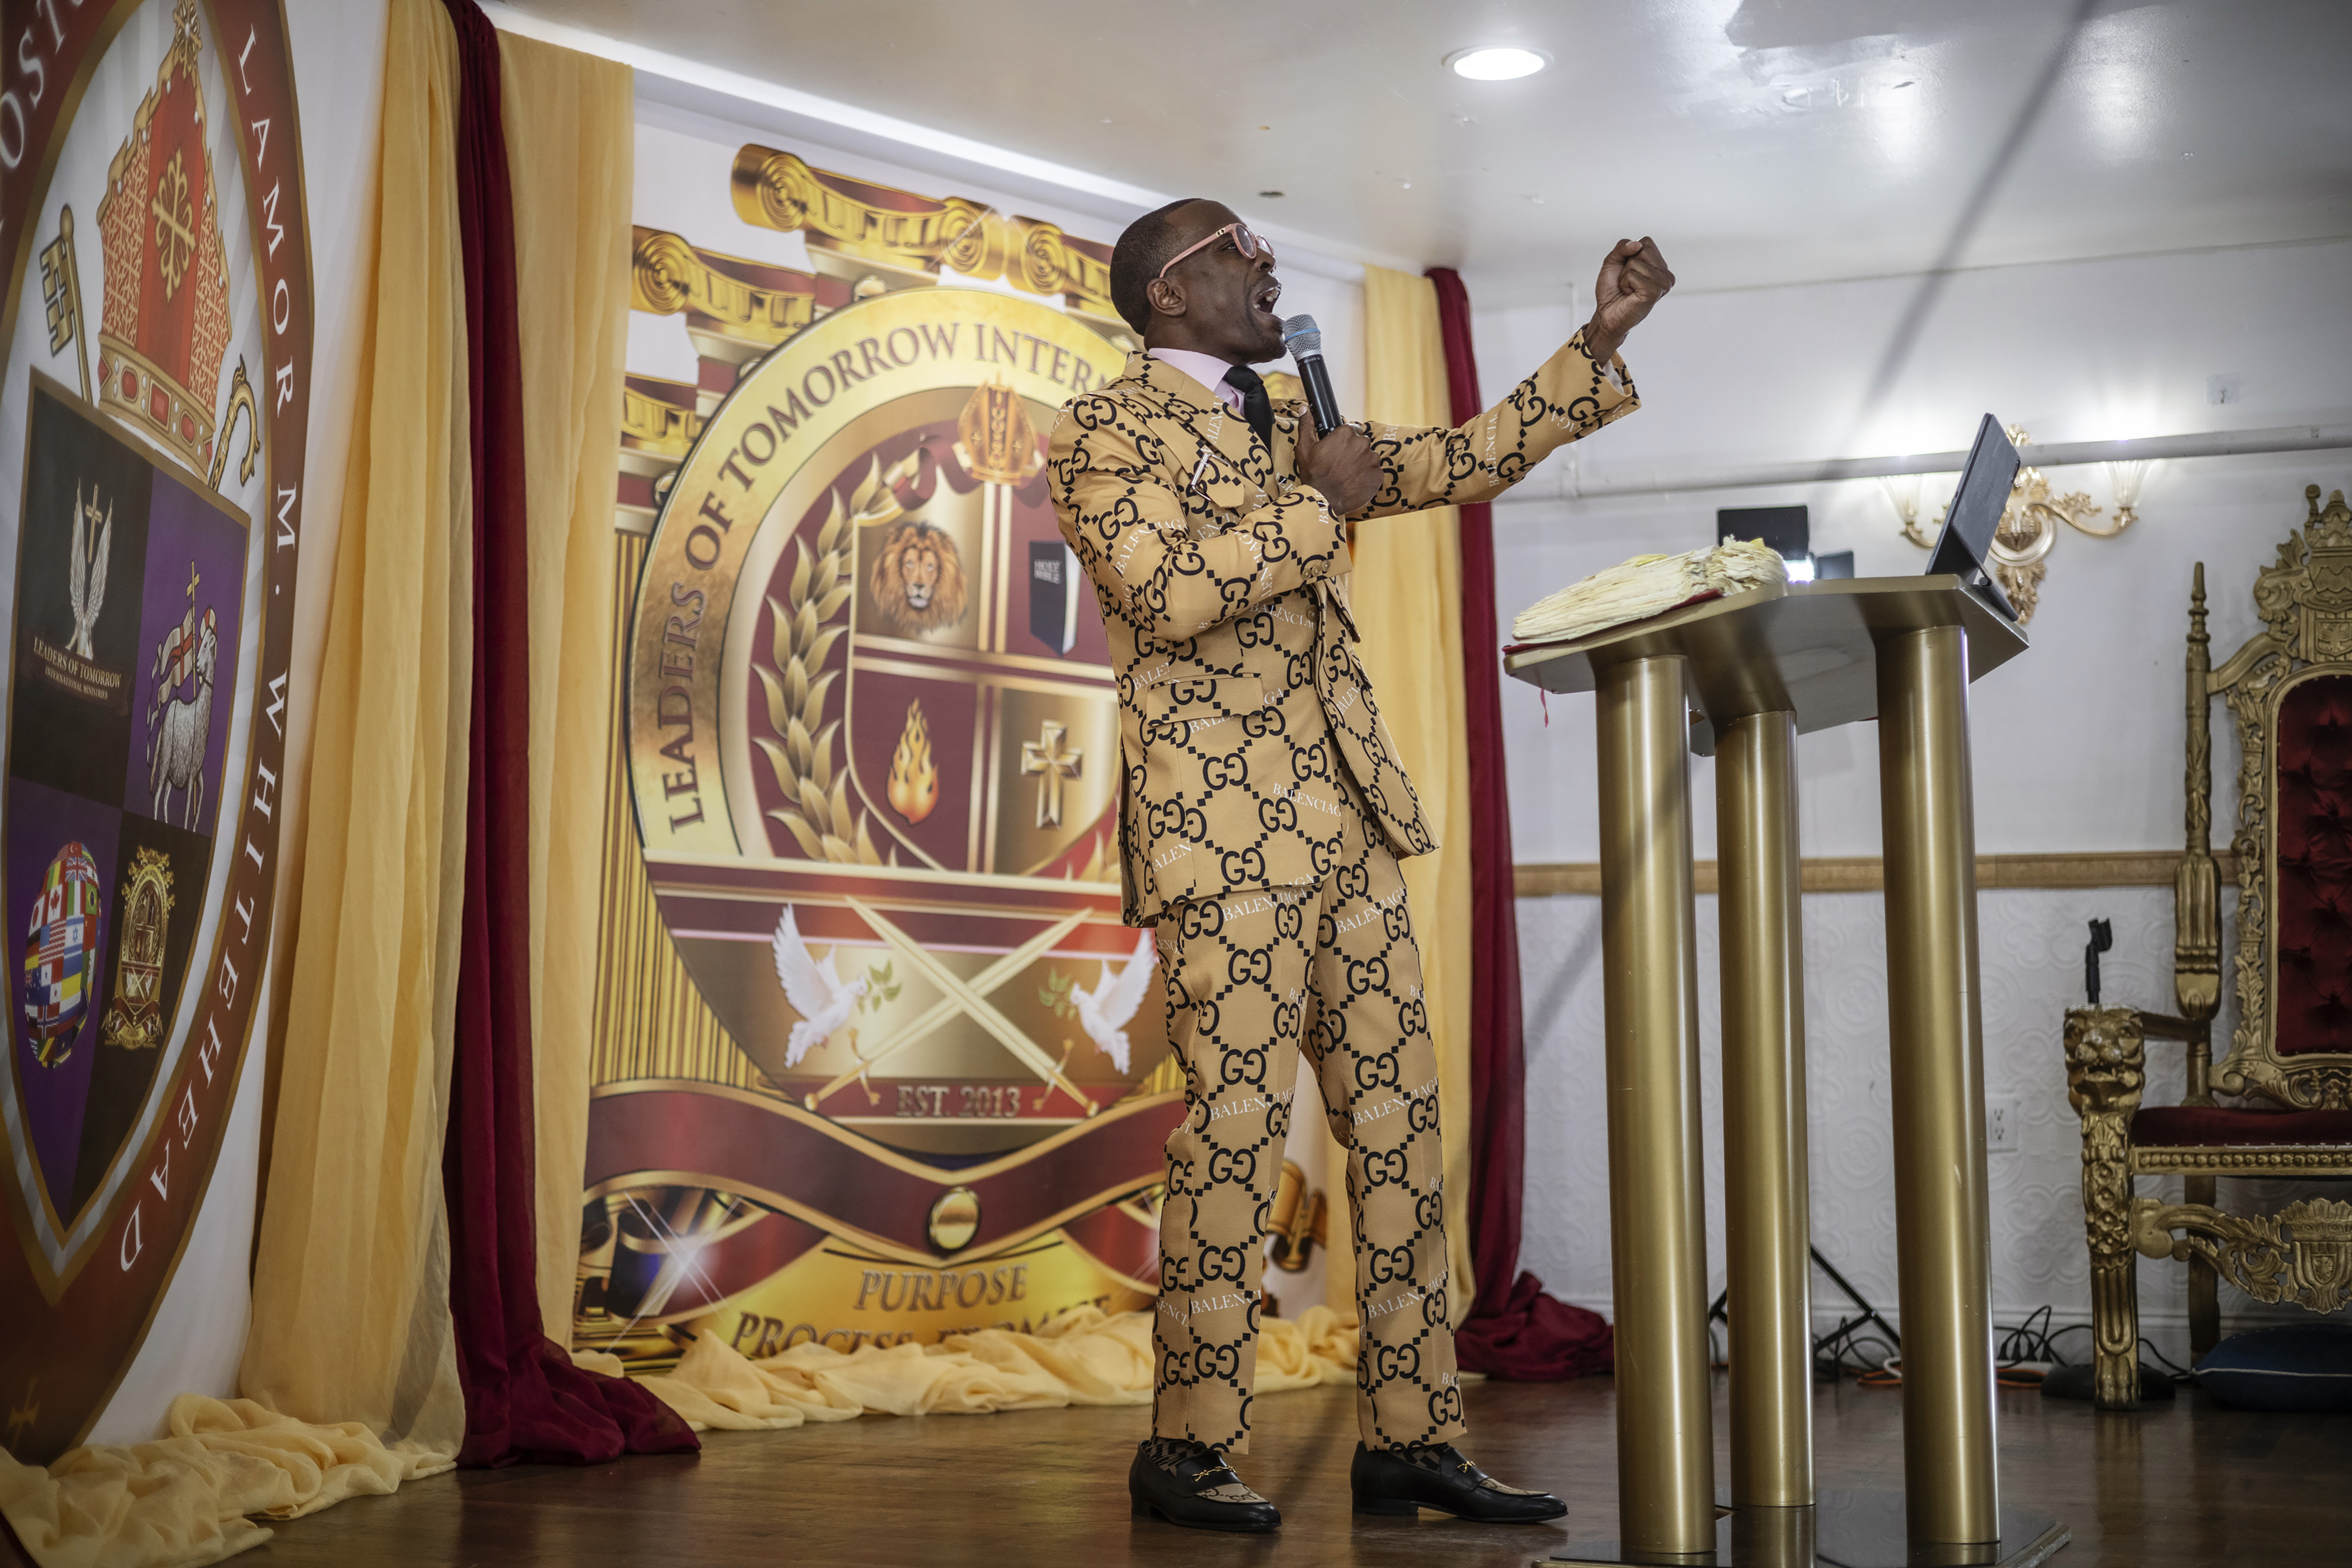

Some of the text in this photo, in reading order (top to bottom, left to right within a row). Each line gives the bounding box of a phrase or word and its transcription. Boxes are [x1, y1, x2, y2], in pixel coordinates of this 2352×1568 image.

[0, 0, 86, 168] OST
[238, 23, 294, 419] LAMOR
[1486, 414, 1500, 487] BALENCIA
[658, 581, 707, 834] LEADERS
[684, 491, 734, 571] OF
[717, 321, 961, 493] TOMORROW
[1116, 519, 1189, 574] BALENIAG
[33, 636, 121, 689] LEADERS OF TOMORROW
[120, 668, 289, 1272] WHITEHEAD
[896, 1086, 1020, 1118] EST. 2013
[1210, 1085, 1295, 1121] BALENIAG
[853, 1263, 1028, 1312] PURPOSE
